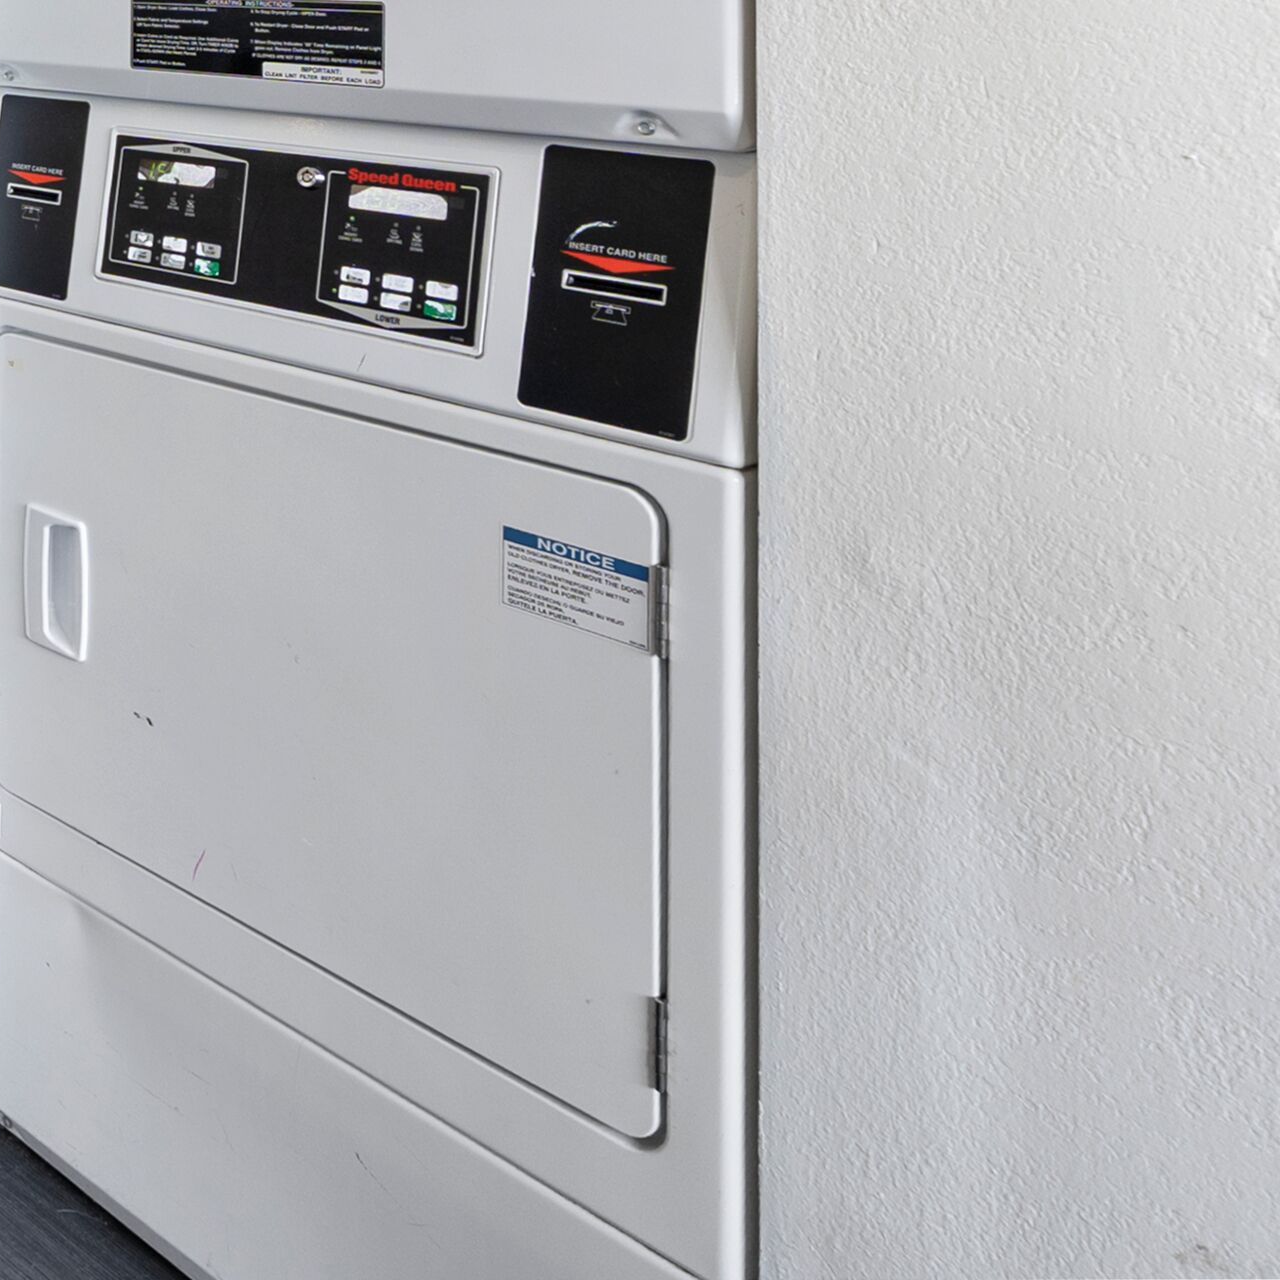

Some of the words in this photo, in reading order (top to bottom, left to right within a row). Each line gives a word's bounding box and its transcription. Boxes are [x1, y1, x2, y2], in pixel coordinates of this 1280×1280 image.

[172, 146, 191, 154] UPPER
[11, 162, 31, 171] INSERT
[31, 165, 47, 173] CARD
[48, 168, 64, 176] HERE
[348, 168, 399, 185] Speed
[402, 174, 458, 192] Queen
[568, 240, 605, 254] INSERT
[606, 246, 636, 259] CARD
[638, 251, 668, 264] HERE
[375, 313, 401, 326] LOWER
